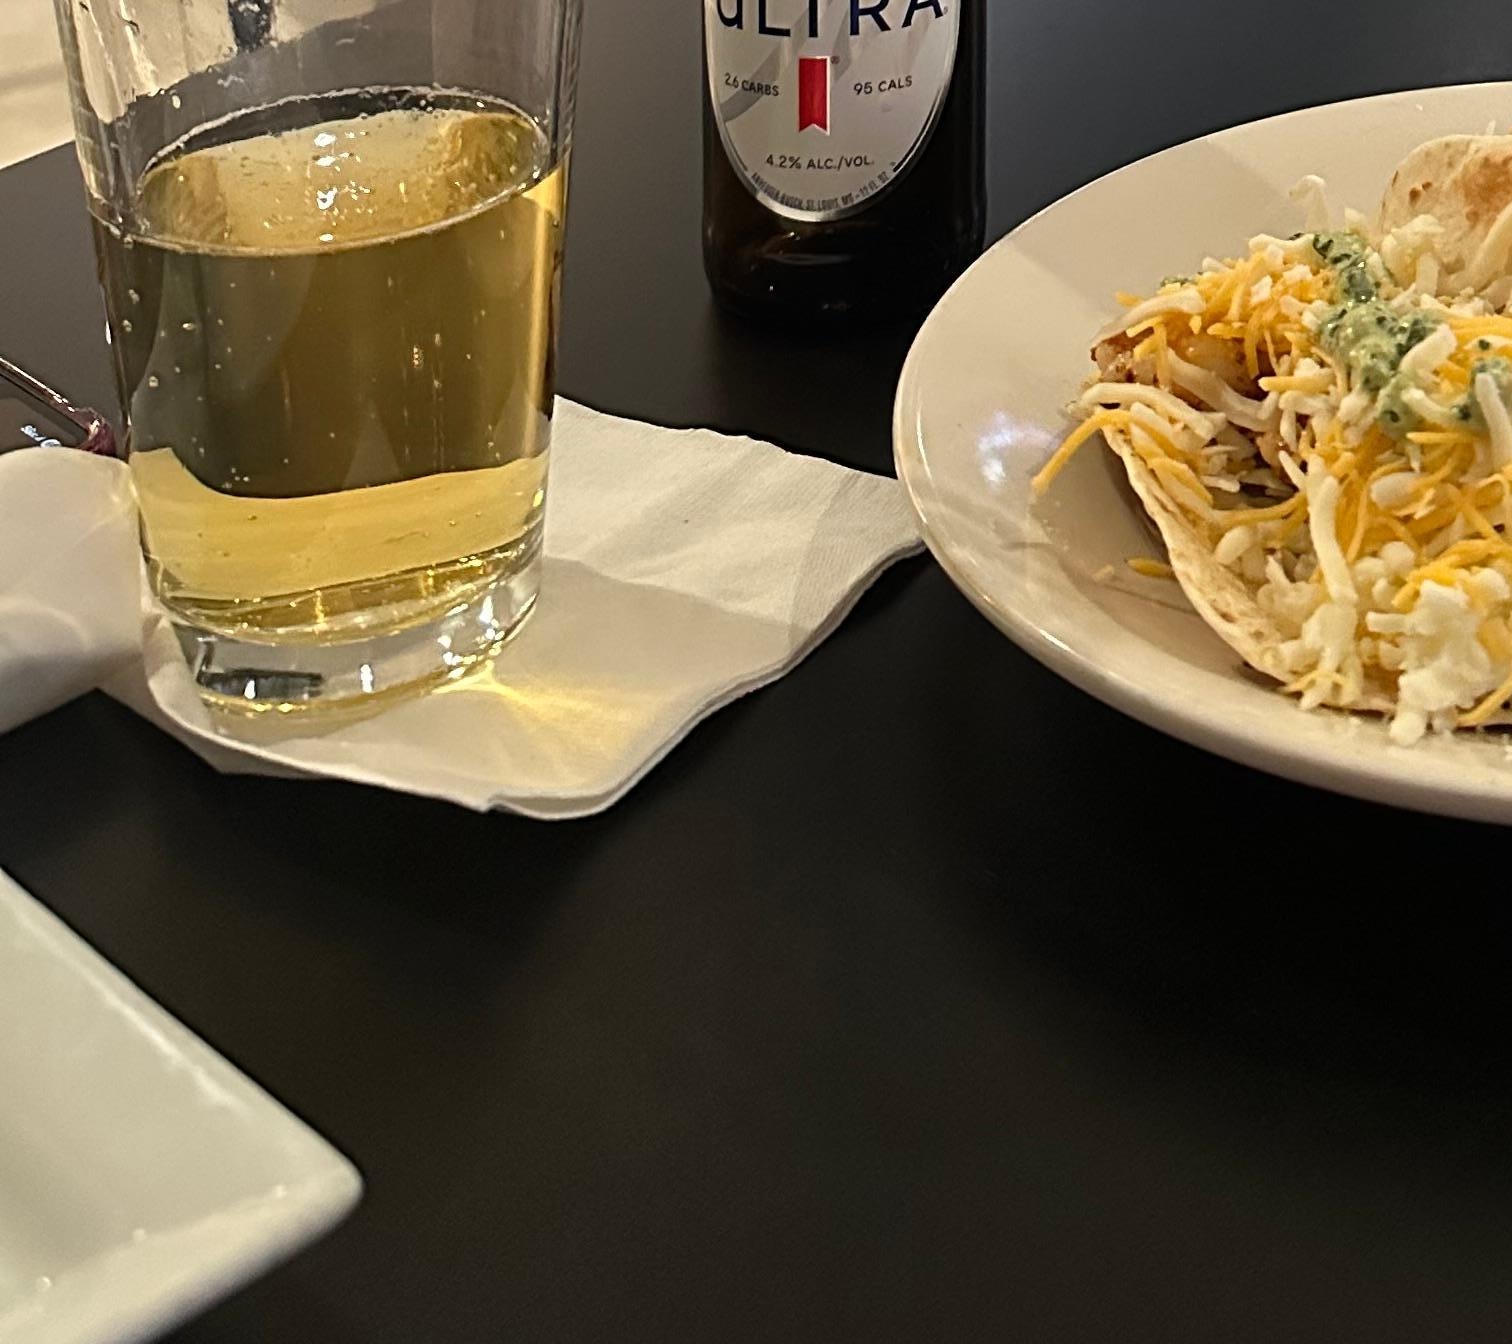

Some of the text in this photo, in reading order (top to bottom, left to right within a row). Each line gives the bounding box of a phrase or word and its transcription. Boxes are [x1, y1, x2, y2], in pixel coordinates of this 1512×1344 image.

[741, 82, 780, 97] CARBS
[853, 75, 913, 96] 95 CALS
[765, 154, 802, 170] 4.2%
